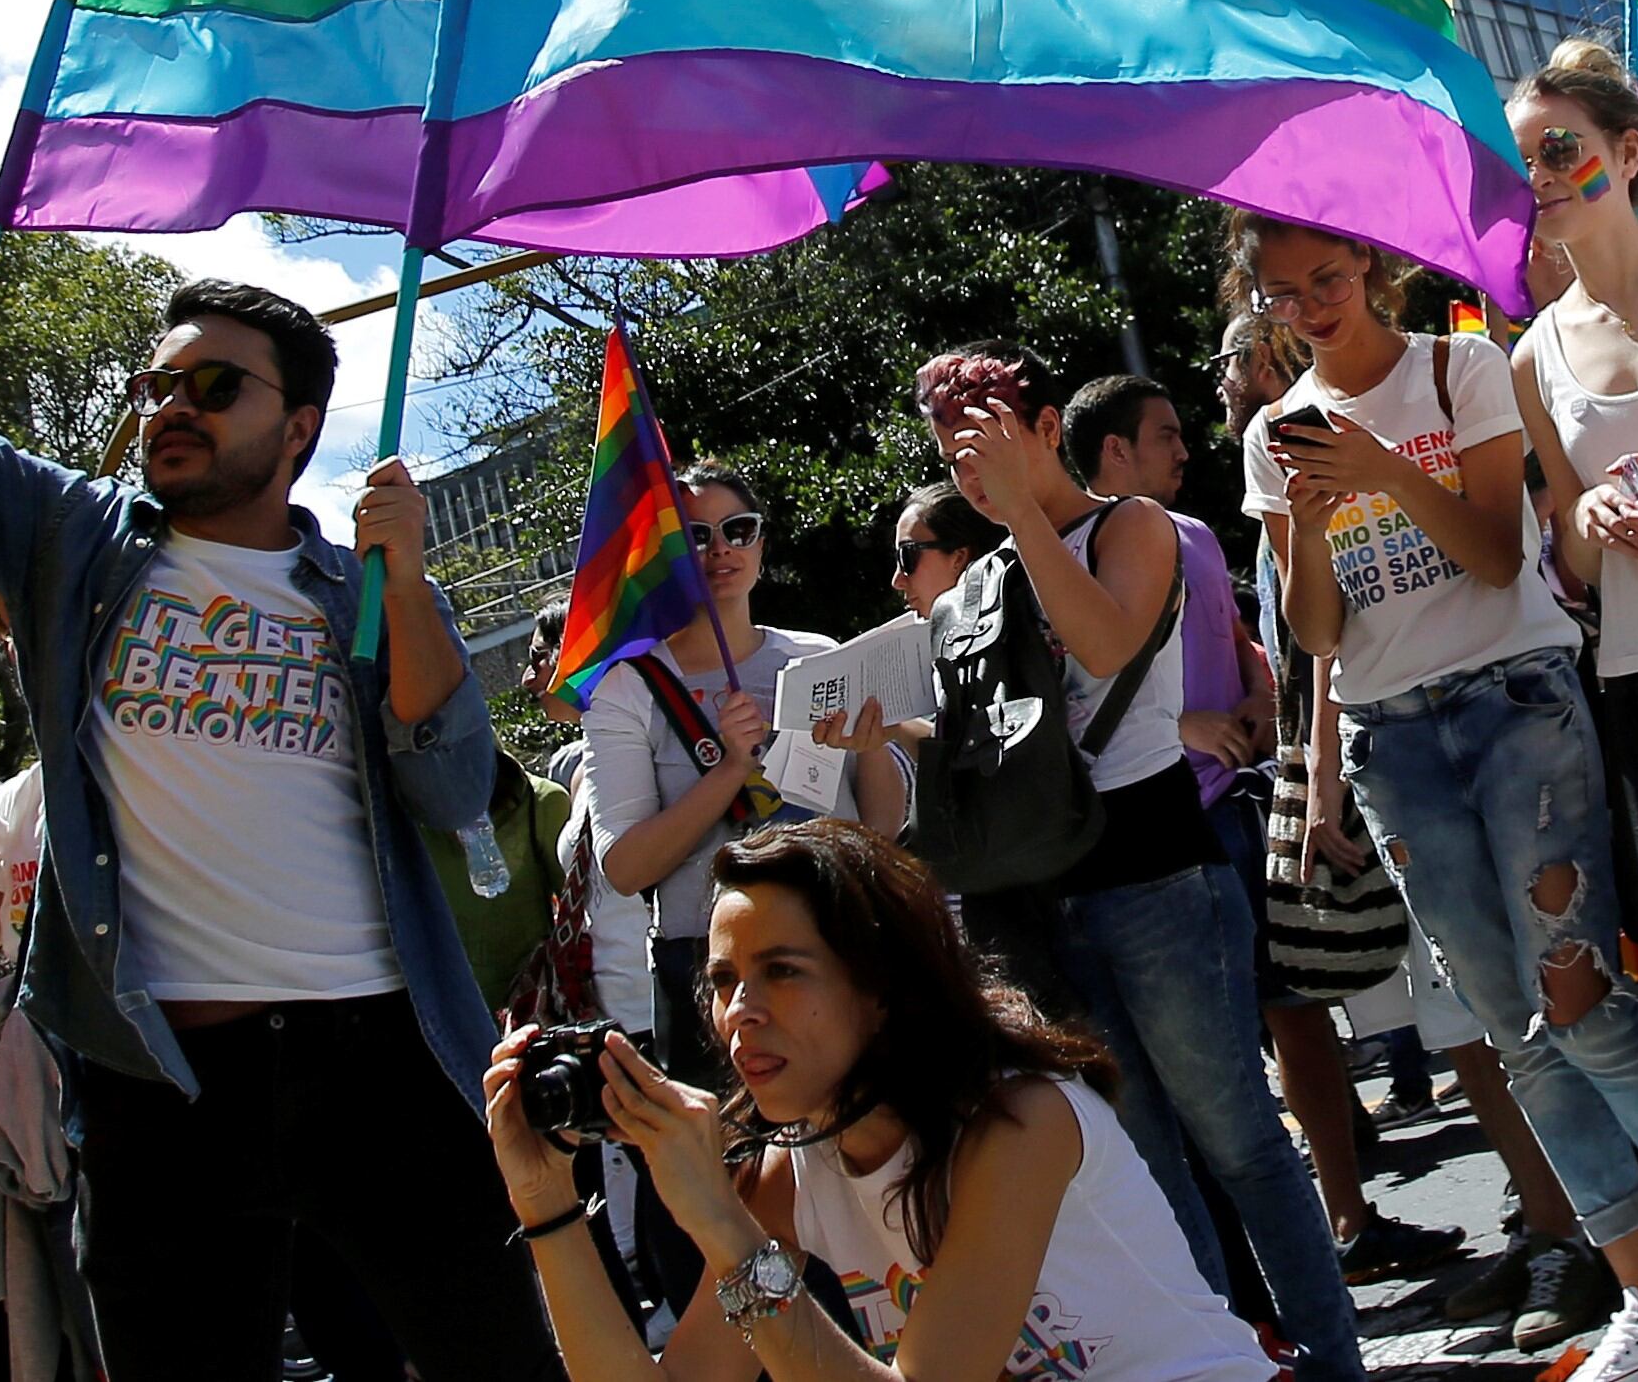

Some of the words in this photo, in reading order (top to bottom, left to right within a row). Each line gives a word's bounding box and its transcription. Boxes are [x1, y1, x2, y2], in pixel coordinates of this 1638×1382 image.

[1391, 430, 1456, 457] PIENS
[1328, 505, 1365, 532] MO
[1331, 526, 1371, 553] MO
[1388, 545, 1446, 577] SAPI
[1392, 559, 1465, 595] SAPIE
[137, 602, 204, 650] IT
[211, 611, 341, 665] GET
[120, 645, 349, 720] BETTER
[811, 681, 826, 712] GETS
[113, 699, 342, 761] COLOMBIA
